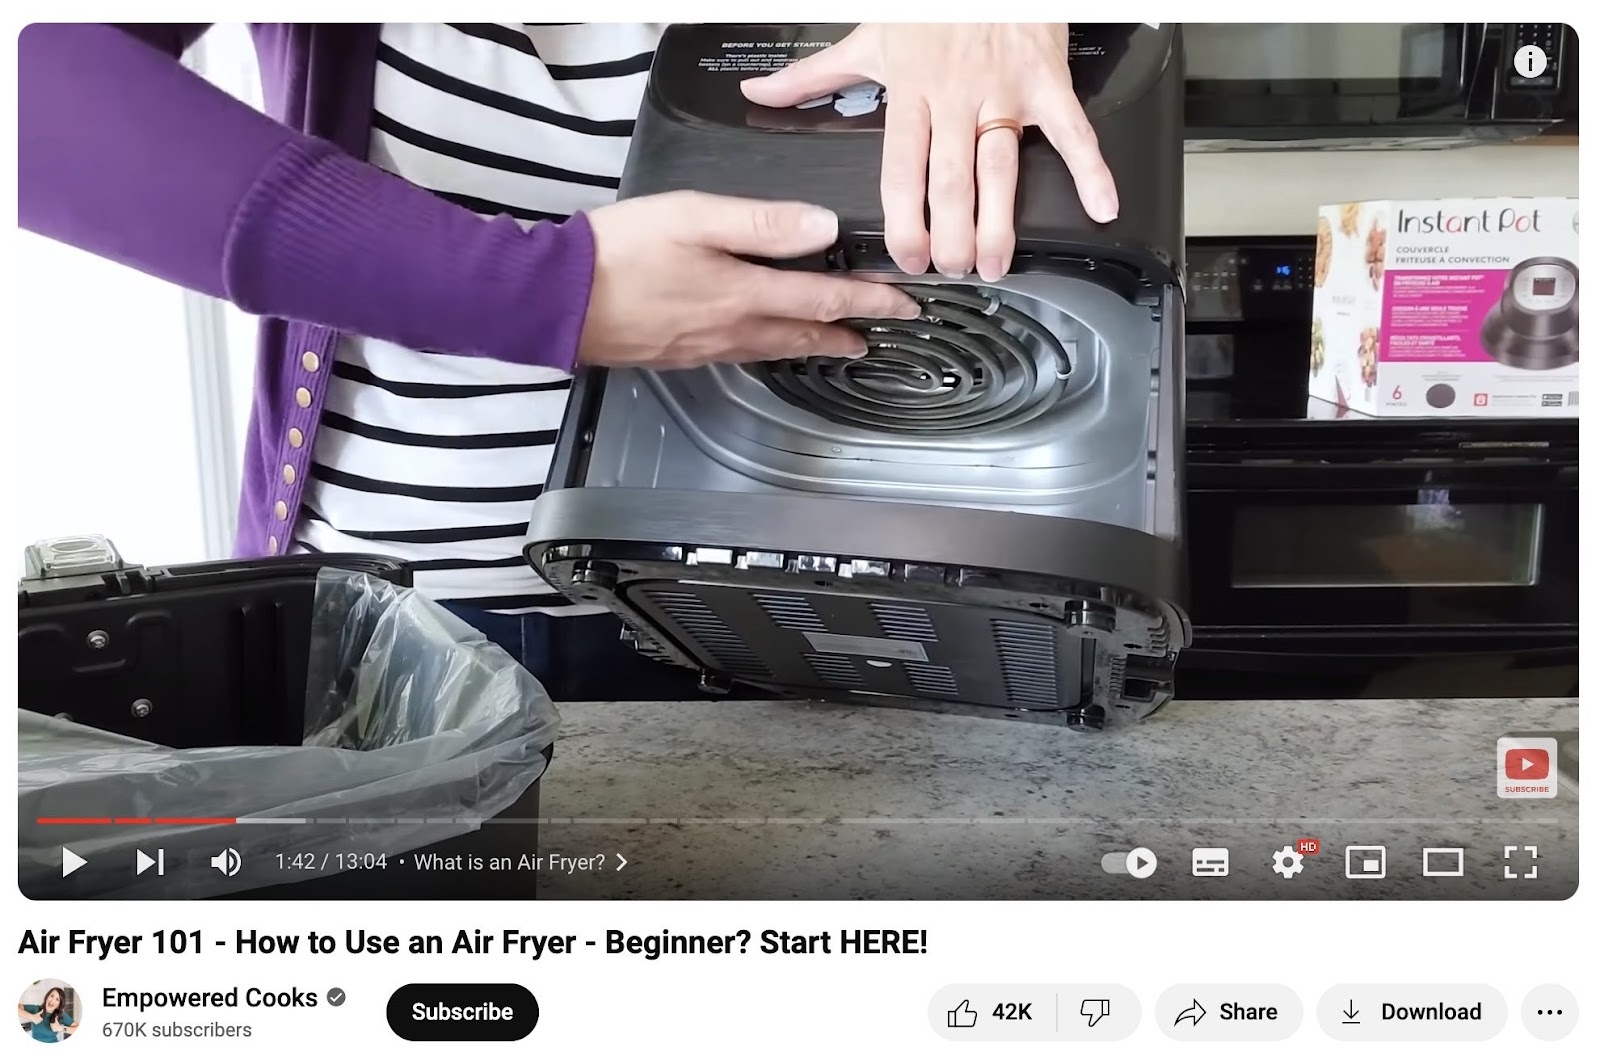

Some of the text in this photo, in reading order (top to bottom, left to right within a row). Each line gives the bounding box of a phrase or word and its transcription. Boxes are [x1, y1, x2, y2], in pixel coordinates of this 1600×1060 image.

[1398, 208, 1542, 233] Instant Pot
[1396, 246, 1450, 254] COUVERCLE
[1396, 256, 1437, 264] FRITEUSE
[1392, 385, 1402, 400] 6
